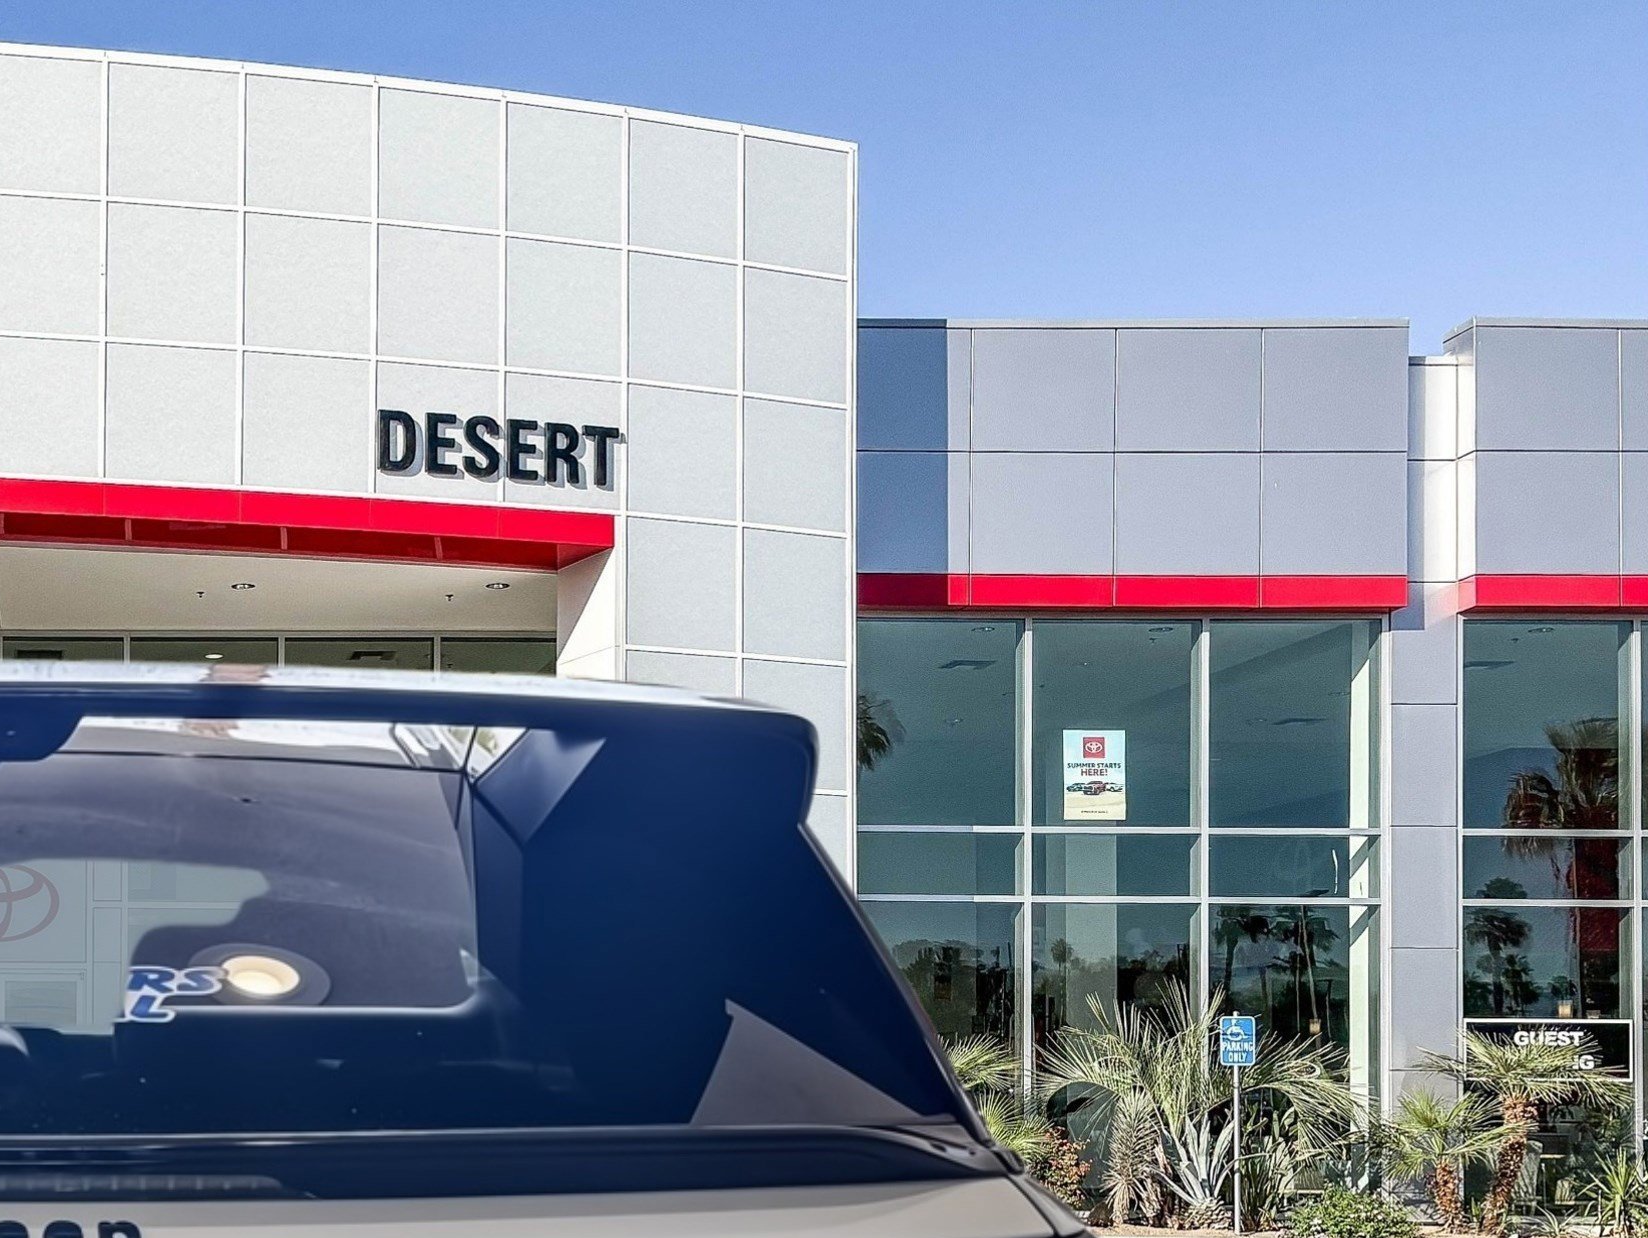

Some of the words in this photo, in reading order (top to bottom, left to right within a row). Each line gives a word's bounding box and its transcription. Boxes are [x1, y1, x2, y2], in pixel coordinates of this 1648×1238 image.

[377, 409, 621, 487] DESERT
[1081, 768, 1108, 777] HERE!
[1513, 1030, 1584, 1047] GUEST
[1222, 1041, 1253, 1051] PARKING
[1229, 1052, 1248, 1062] ONLY
